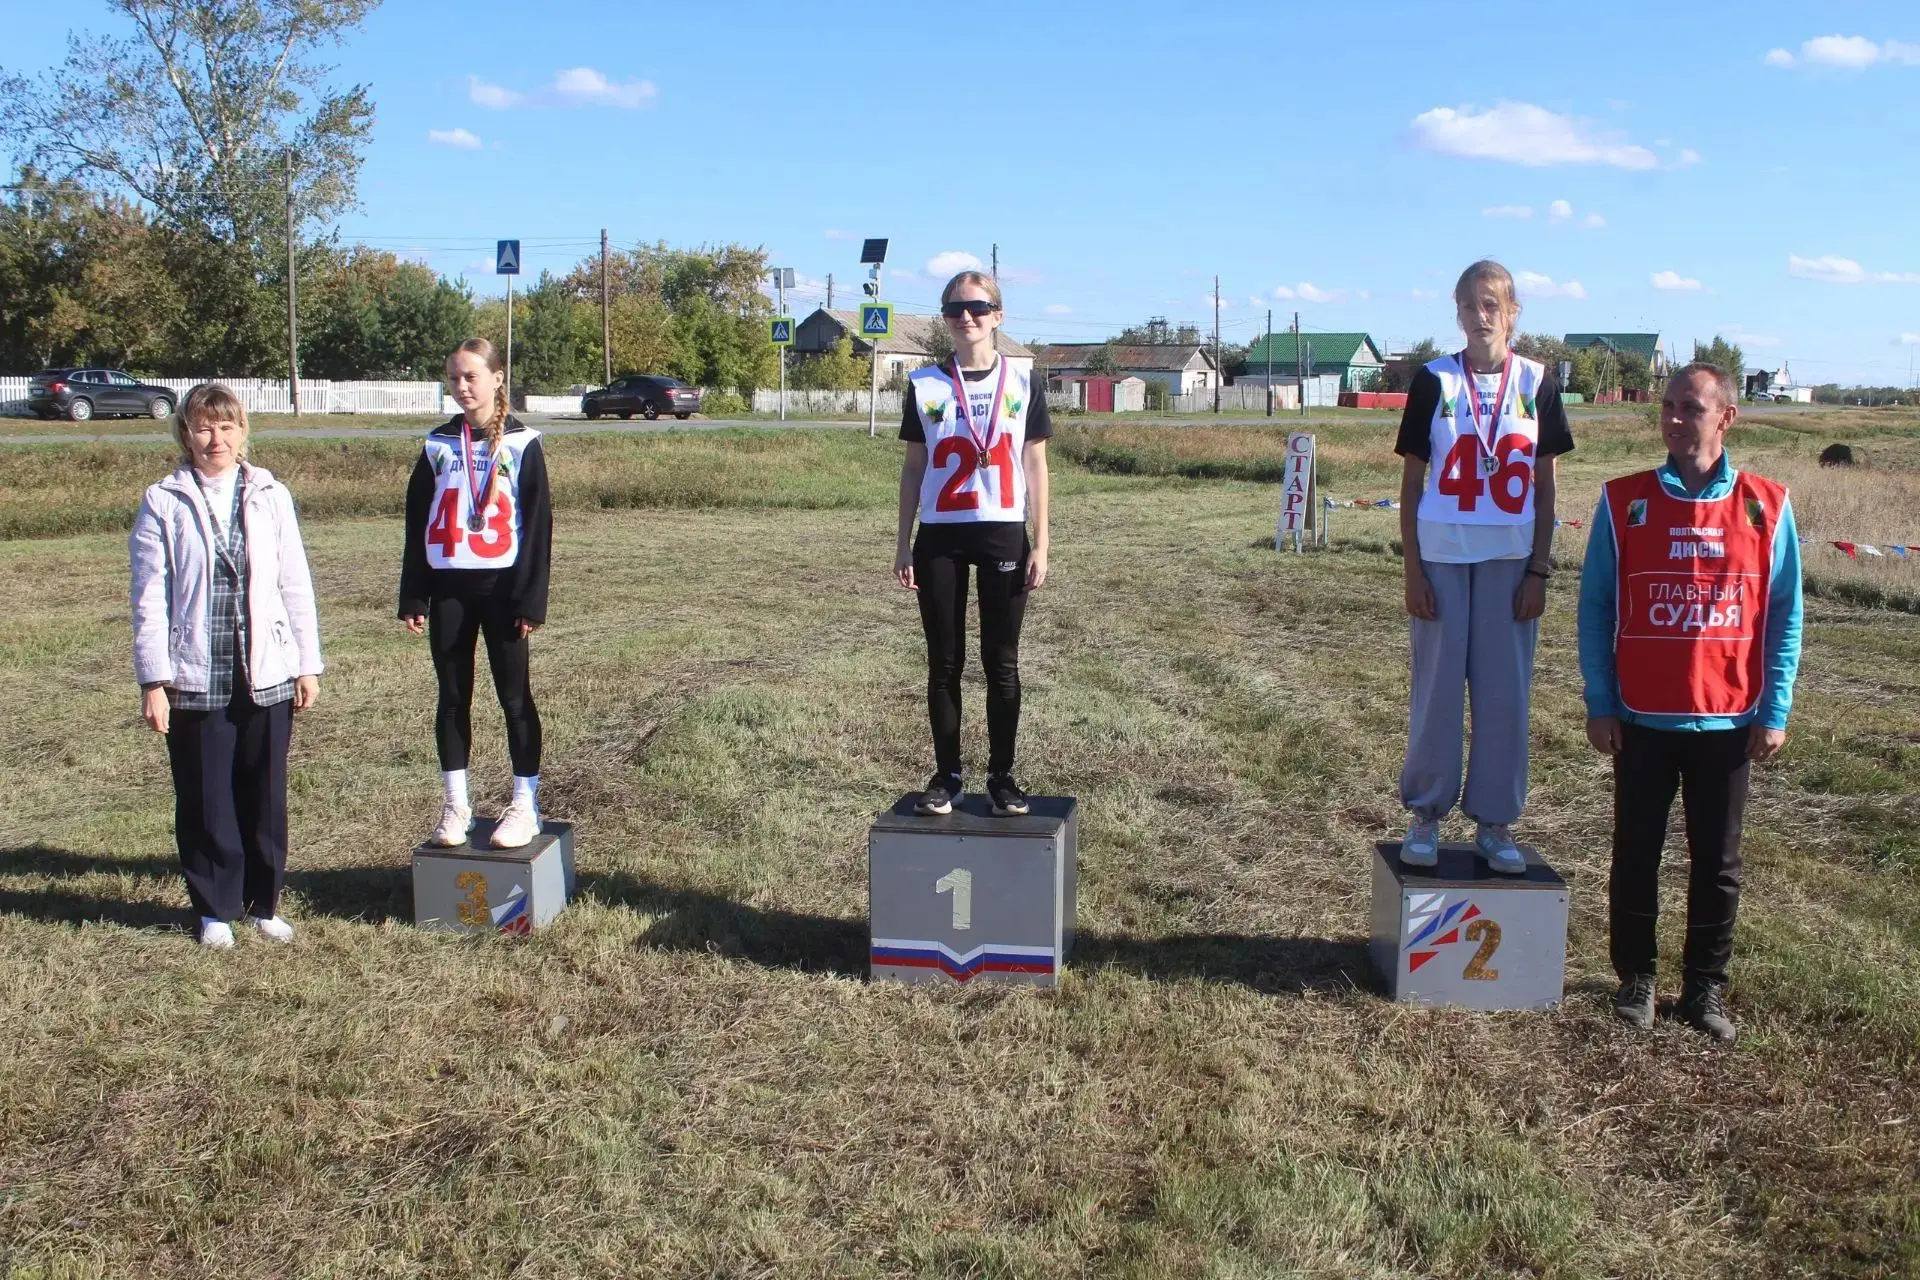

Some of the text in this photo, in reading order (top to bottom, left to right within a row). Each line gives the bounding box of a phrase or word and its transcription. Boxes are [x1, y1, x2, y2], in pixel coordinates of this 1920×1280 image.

[933, 432, 1014, 513] 21
[1283, 436, 1310, 530] СТАРТ
[1438, 432, 1534, 514] 46
[428, 487, 513, 558] 43
[1669, 527, 1724, 537] ПОЛТАВСКАЯ
[1669, 541, 1725, 560] ДЮСШ
[1649, 581, 1745, 602] ГЛАВНЫЙ
[1649, 603, 1743, 632] СУДЬЯ
[456, 871, 489, 926] 3
[935, 868, 972, 930] 1
[1463, 919, 1502, 981] 2
